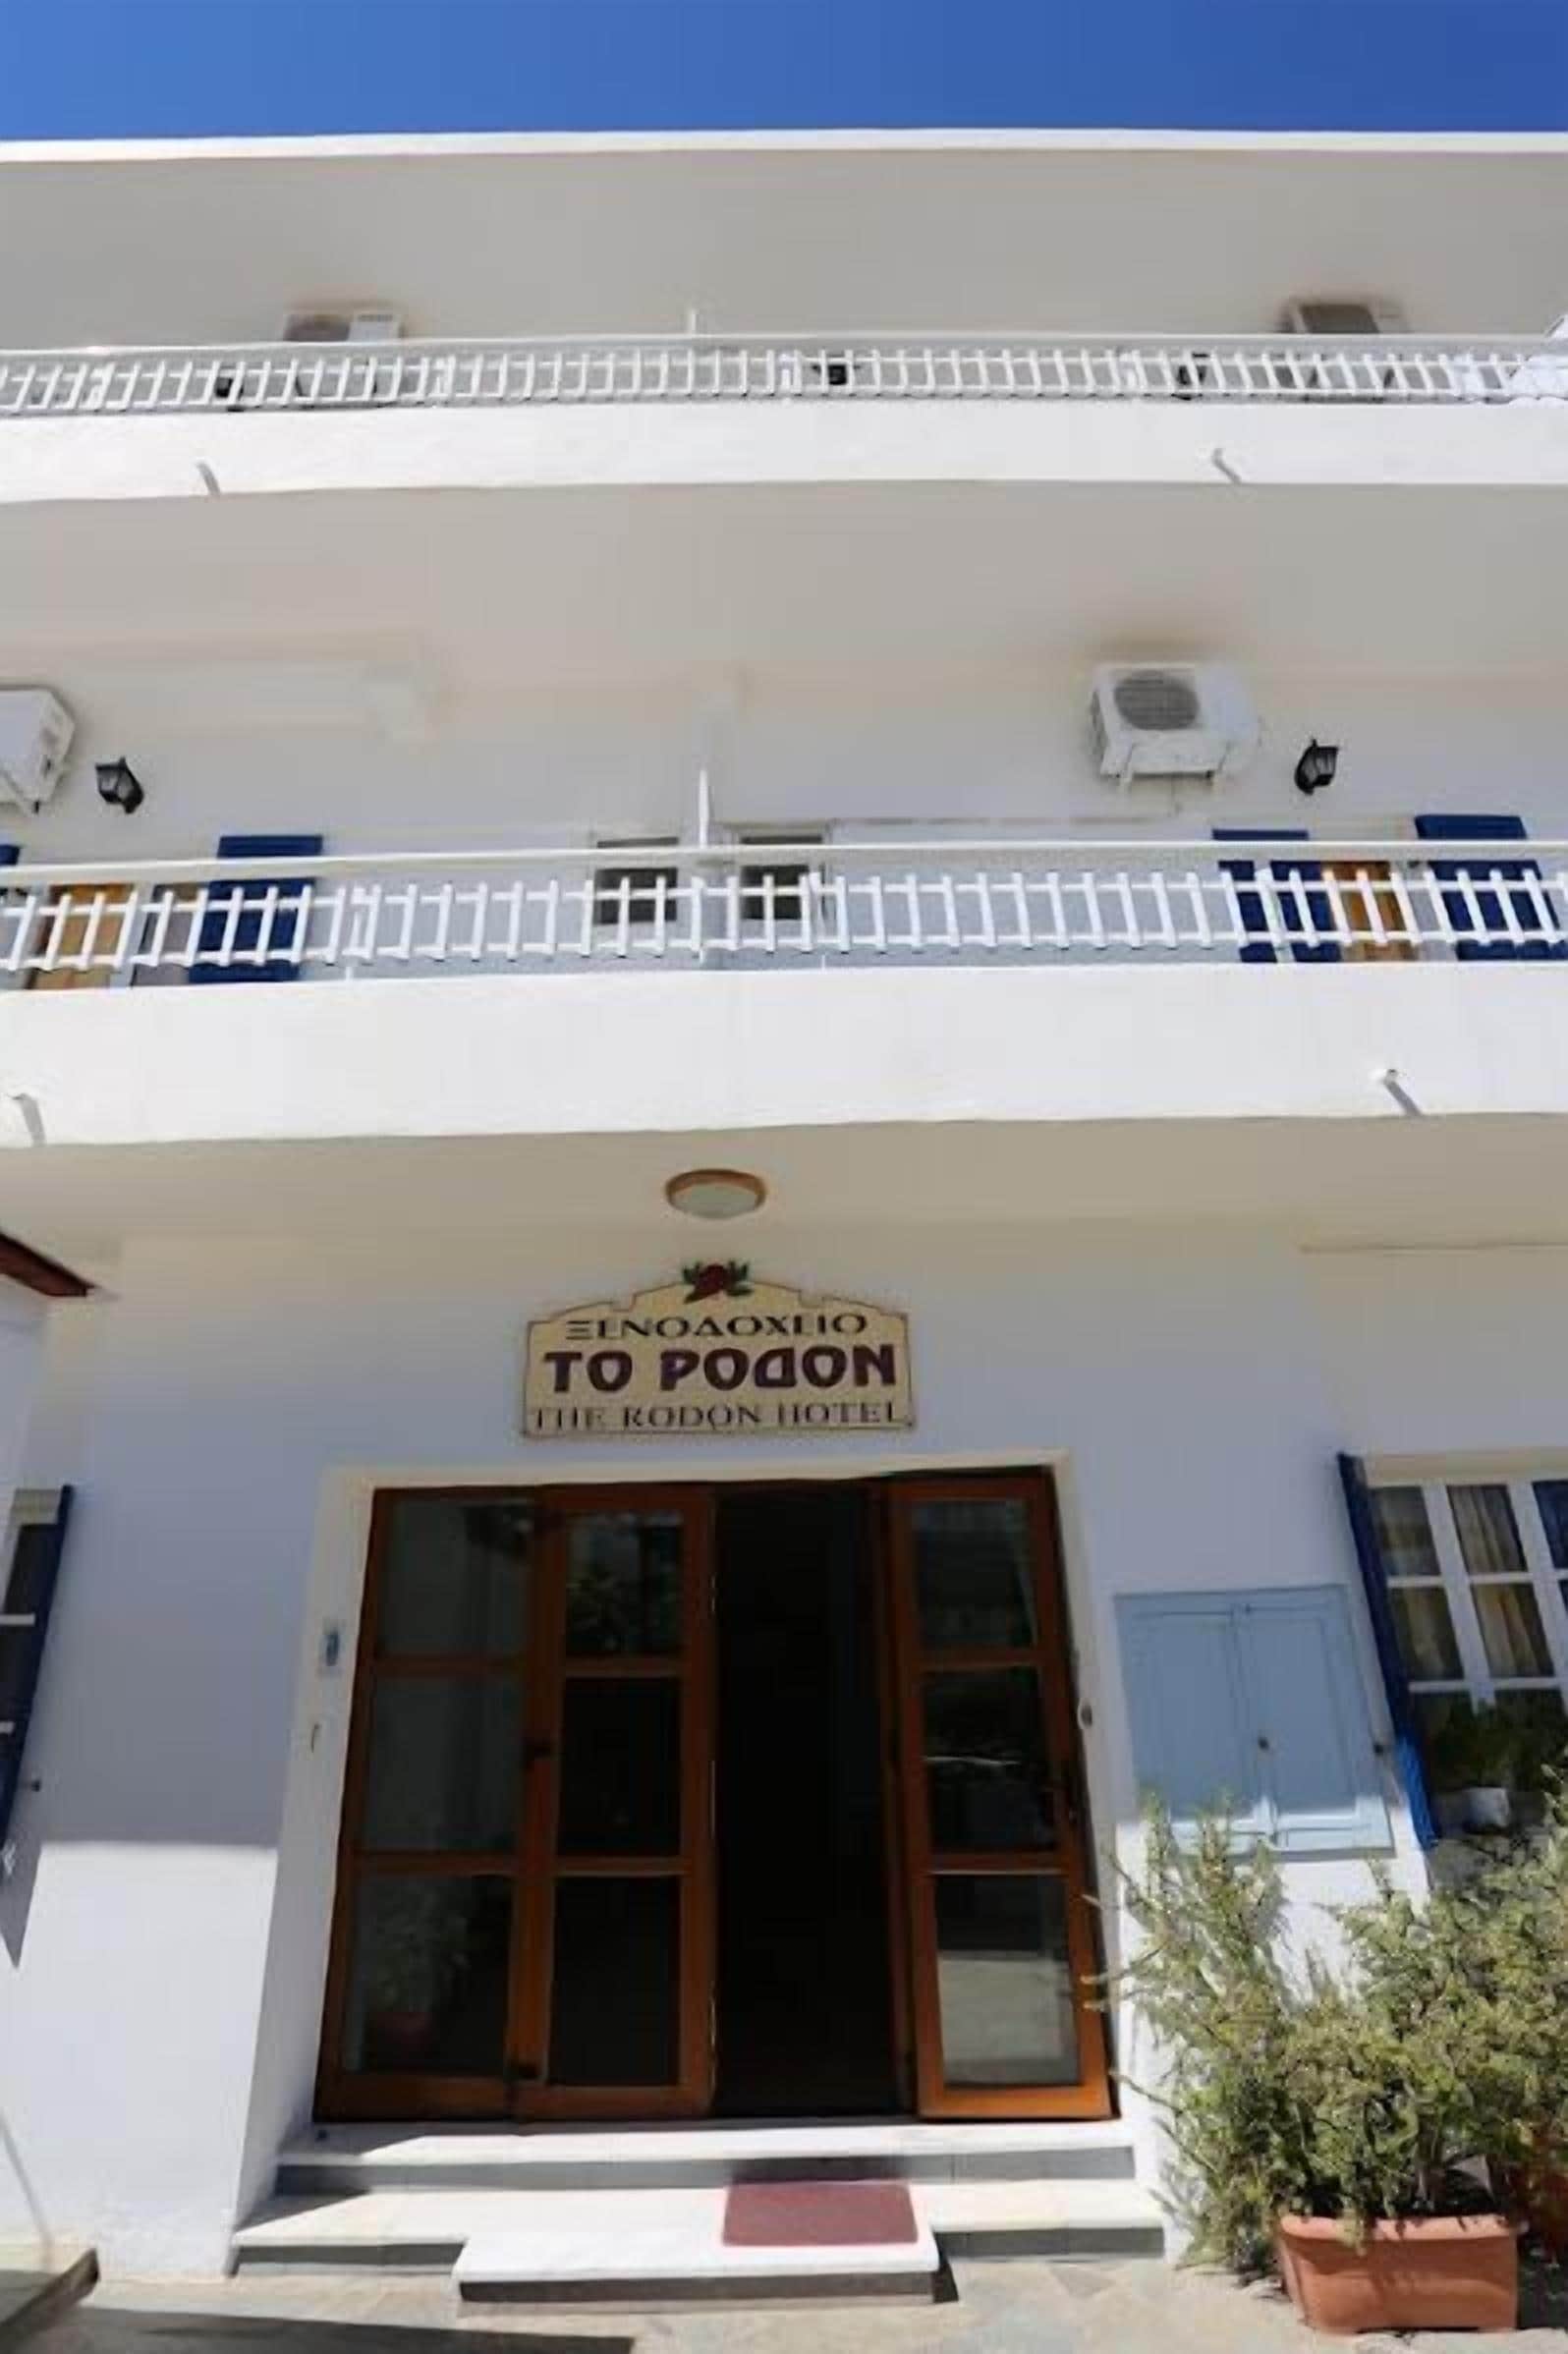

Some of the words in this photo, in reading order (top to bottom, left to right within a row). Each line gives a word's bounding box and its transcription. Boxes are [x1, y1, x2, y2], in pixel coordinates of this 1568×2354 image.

[536, 1406, 603, 1430] THE
[623, 1403, 761, 1429] RODON
[778, 1401, 898, 1426] HOTEL
